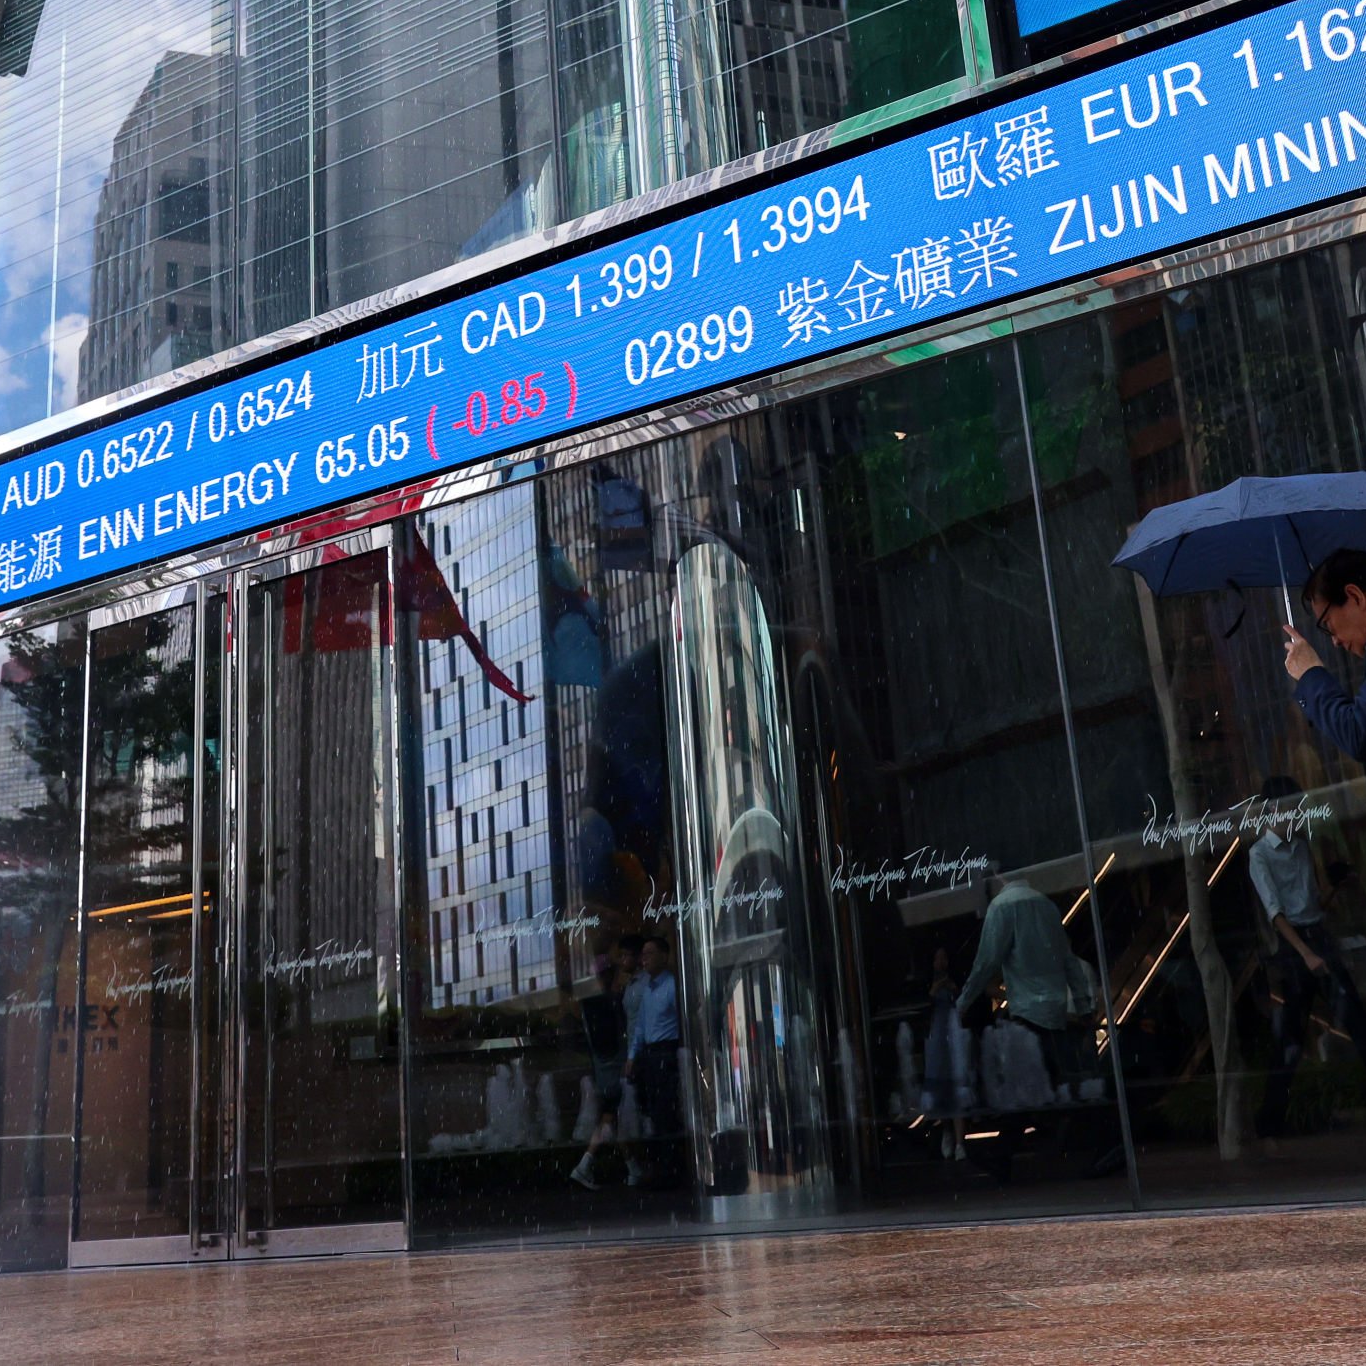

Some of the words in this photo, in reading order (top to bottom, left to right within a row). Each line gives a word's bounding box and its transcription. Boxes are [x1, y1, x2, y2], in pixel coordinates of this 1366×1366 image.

[1, 460, 66, 515] AUD
[77, 420, 174, 488] 0.6522
[208, 370, 315, 443] 0.6524
[355, 320, 446, 404] 加元
[460, 290, 547, 355] CAD
[565, 244, 674, 318] 1.399
[723, 174, 871, 264] 1.3994
[927, 105, 1060, 201] 歐羅
[1081, 61, 1209, 144] EUR
[78, 503, 145, 560] ENN
[154, 451, 299, 536] ENERGY
[315, 415, 410, 484] 65.05
[624, 304, 754, 386] 02899
[1045, 164, 1188, 255] ZIJIN
